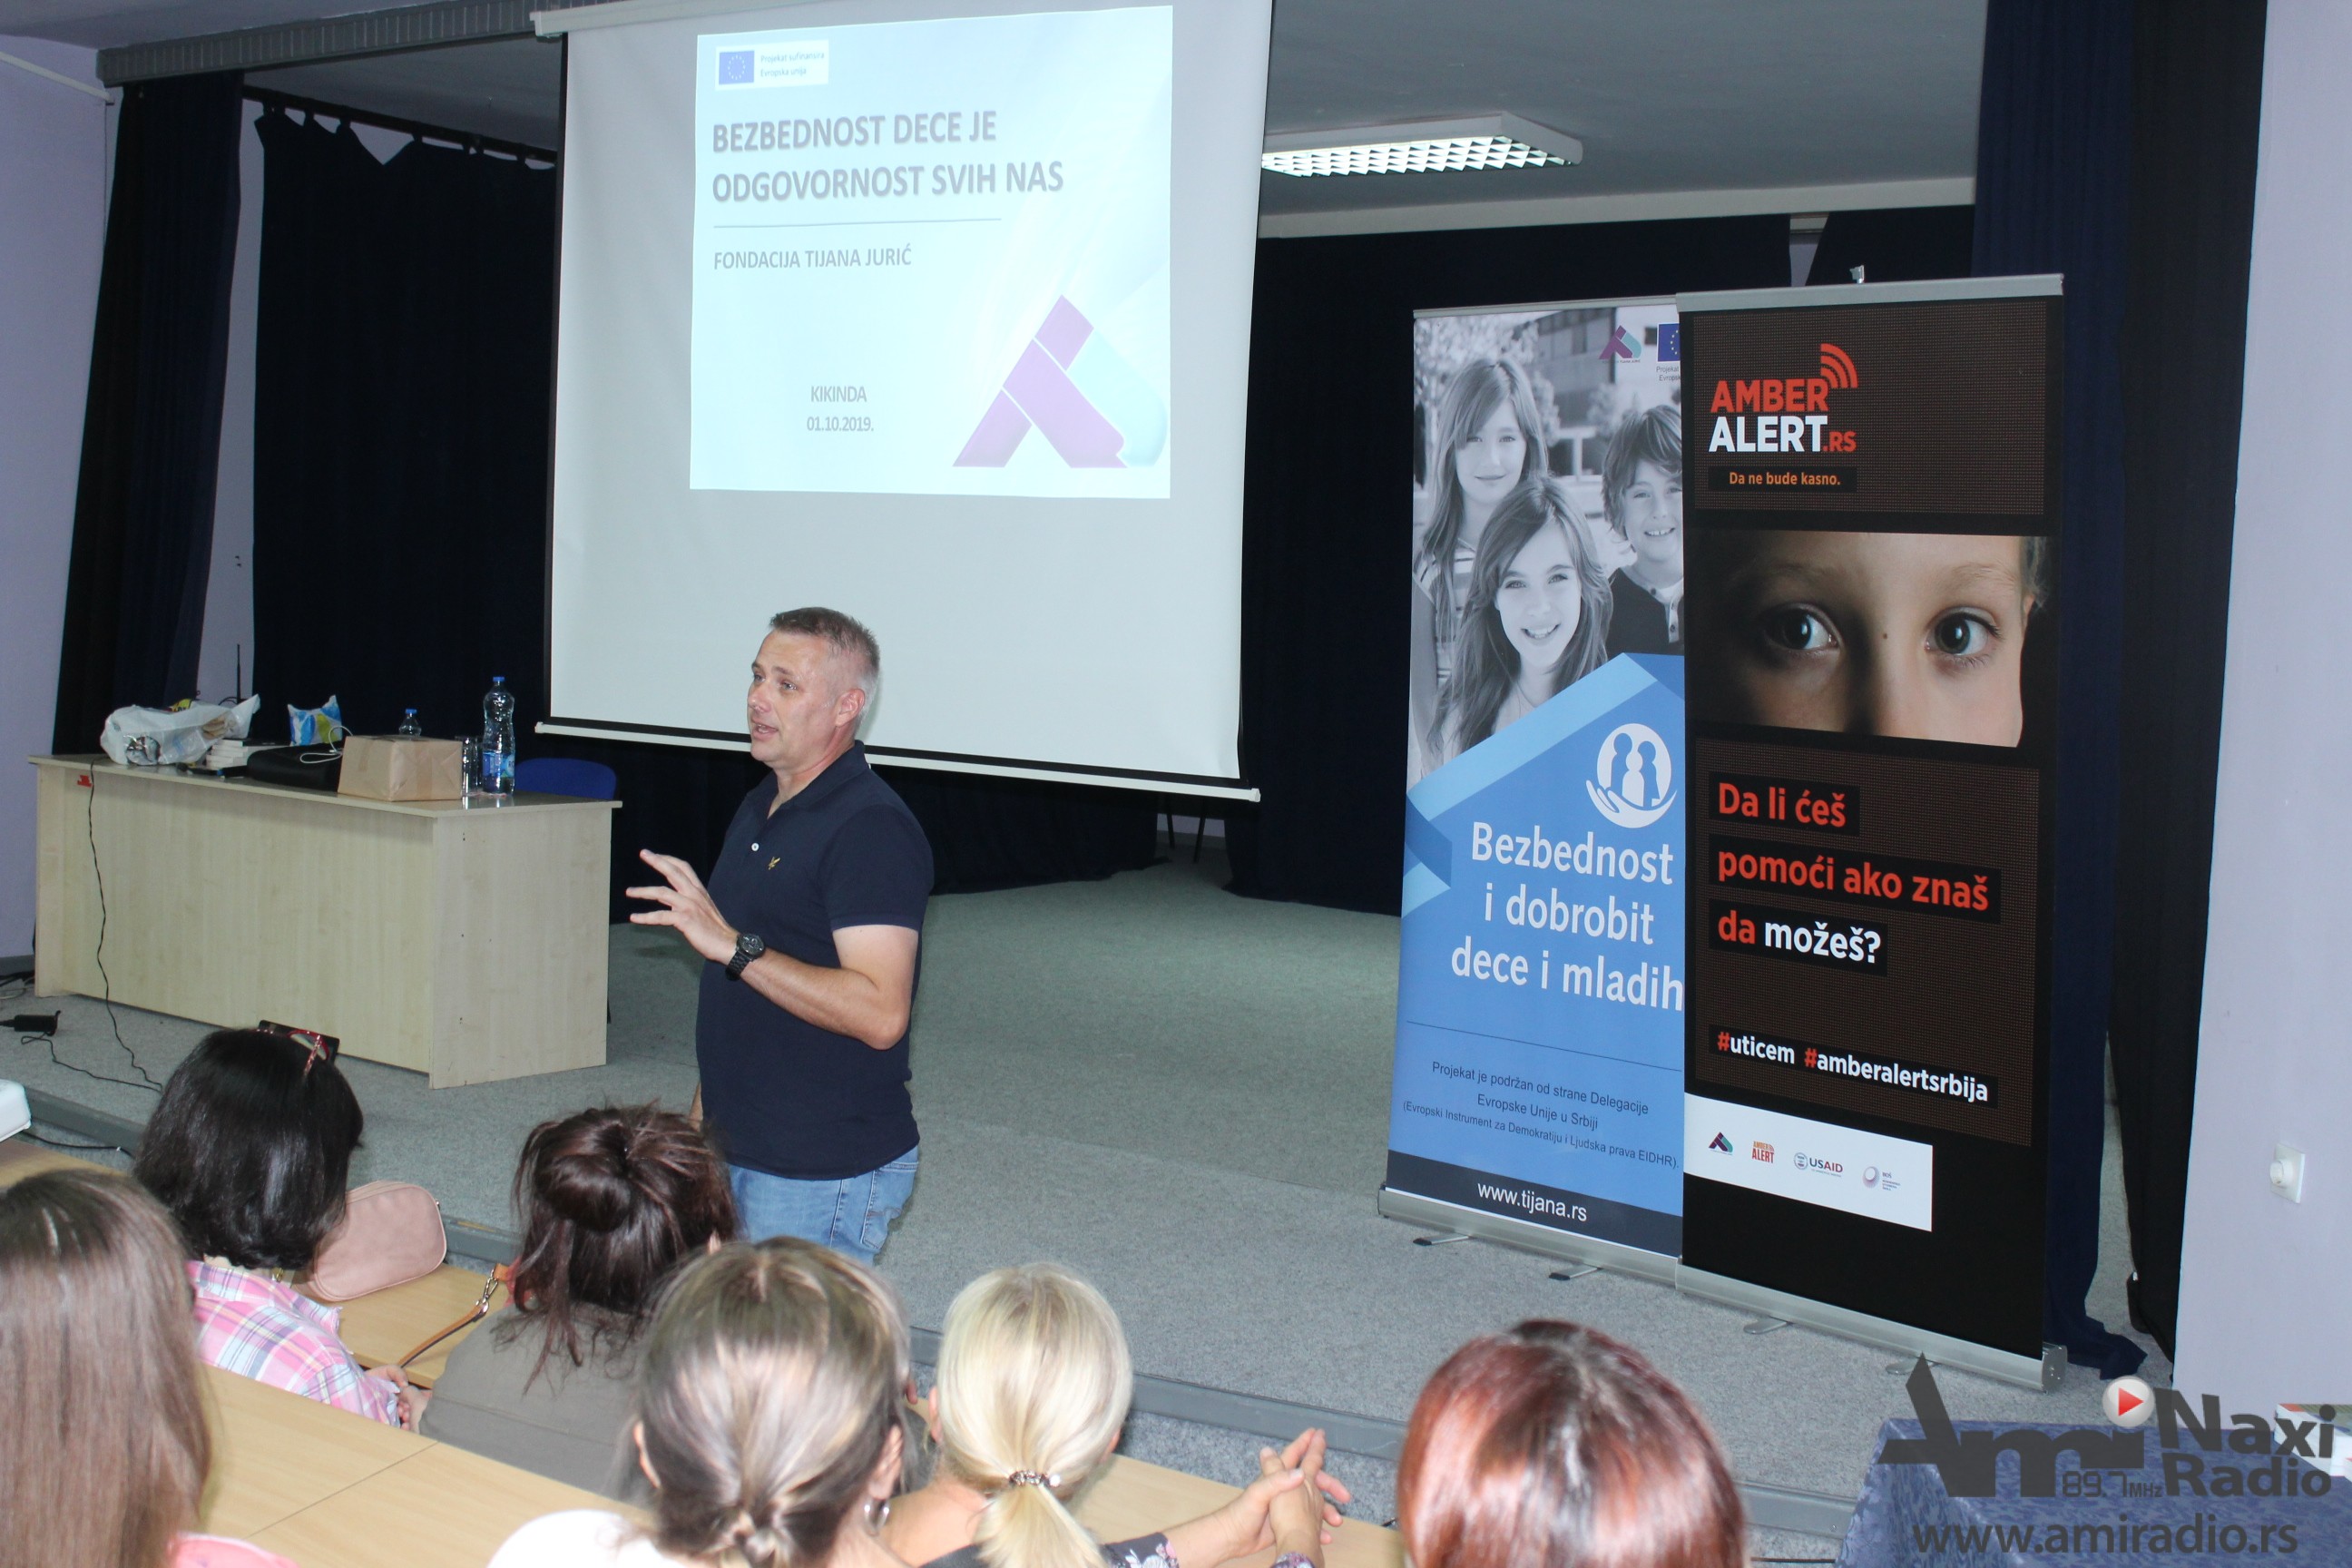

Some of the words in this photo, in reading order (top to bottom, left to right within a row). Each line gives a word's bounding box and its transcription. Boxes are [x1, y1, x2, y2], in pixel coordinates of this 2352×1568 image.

[712, 114, 886, 154] BEZBEDNOST
[893, 112, 962, 144] DECE
[969, 110, 997, 142] JE
[712, 165, 924, 203] ODGOVORNOST
[931, 163, 996, 195] SVIH
[1005, 161, 1064, 193] NAS
[713, 250, 801, 270] FONDACIJA
[804, 249, 861, 268] TIJANA
[865, 243, 912, 267] JURIĆ
[810, 386, 867, 403] KIKINDA
[1710, 377, 1829, 413] AMBER
[807, 416, 874, 432] 01.10.2019.
[1730, 472, 1745, 485] Da
[1749, 475, 1763, 485] ne
[1767, 473, 1798, 485] bude
[1801, 472, 1840, 485] kasno.
[1718, 782, 1759, 818] Da
[1769, 786, 1786, 820] li
[1795, 789, 1847, 828] ćeš
[1472, 821, 1674, 886] Bezbednost
[1718, 850, 1834, 891] pomoći
[1843, 861, 1902, 899] ako
[1912, 874, 1989, 911] znaš
[1485, 882, 1493, 922] i
[1505, 883, 1654, 946] dobrobit
[1718, 910, 1756, 945] da
[1764, 920, 1881, 964] možeš?
[1451, 936, 1529, 986] dece
[1541, 950, 1549, 990] i
[1563, 956, 1683, 1012] mladih
[1432, 1061, 1475, 1080] Projekat
[1477, 1070, 1487, 1084] je
[1490, 1075, 1534, 1092] podržan
[1536, 1083, 1550, 1095] od
[1553, 1086, 1587, 1102] strane
[1591, 1092, 1649, 1116] Delegacije
[1717, 1032, 1795, 1064] #uticem
[1805, 1048, 1988, 1103] #amberalertsrbija
[1403, 1101, 1443, 1119] (Evropski
[1446, 1109, 1492, 1129] Instrument
[1494, 1122, 1505, 1132] za
[1508, 1122, 1563, 1145] Demokratiju
[1564, 1134, 1568, 1144] i
[1570, 1135, 1606, 1152] Ljudska
[1609, 1145, 1636, 1159] prava
[1477, 1093, 1527, 1115] Evropske
[1530, 1103, 1557, 1122] Unije
[1561, 1113, 1567, 1122] u
[1571, 1112, 1598, 1132] Srbiji
[1751, 1148, 1775, 1164] ALERT
[1808, 1157, 1844, 1173] USAID
[1477, 1182, 1587, 1222] www.tijana.rs
